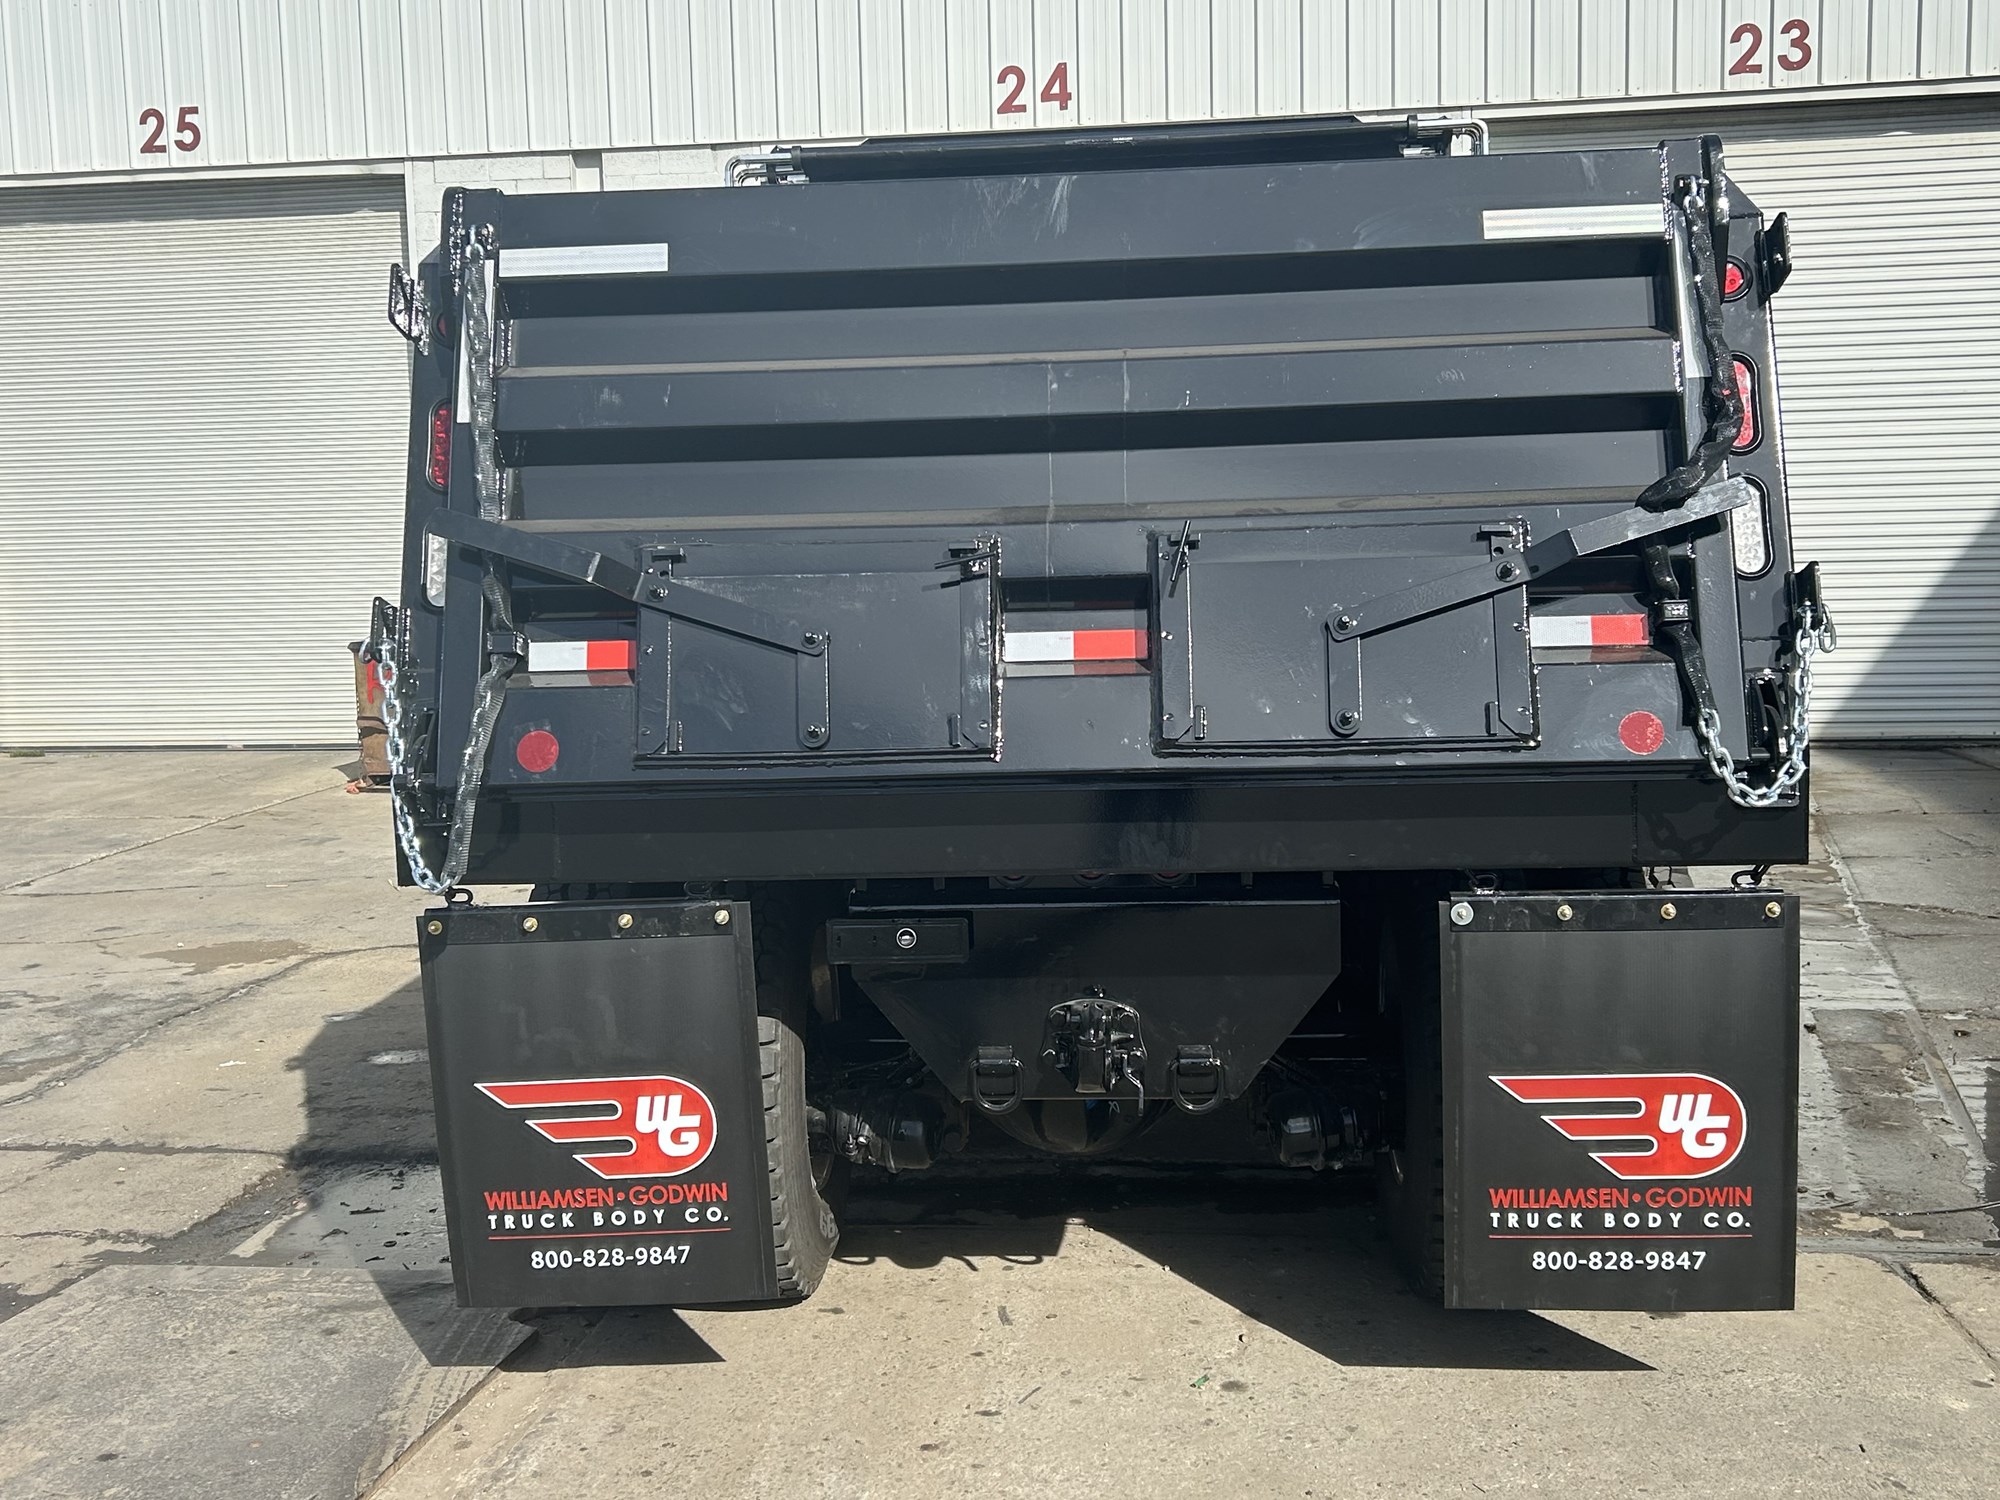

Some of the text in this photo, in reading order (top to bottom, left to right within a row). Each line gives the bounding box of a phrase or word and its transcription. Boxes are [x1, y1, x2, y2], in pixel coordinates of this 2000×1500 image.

[1728, 18, 1812, 76] 23
[997, 62, 1072, 115] 24
[139, 106, 201, 154] 25
[635, 1094, 701, 1157] WG
[1658, 1093, 1730, 1159] WG
[488, 1207, 729, 1230] TRUCK BODY CO.
[1490, 1212, 1751, 1228] TRUCK BODY CO.
[531, 1246, 691, 1269] 800-828-9847
[1532, 1251, 1706, 1270] 800-828-9847
